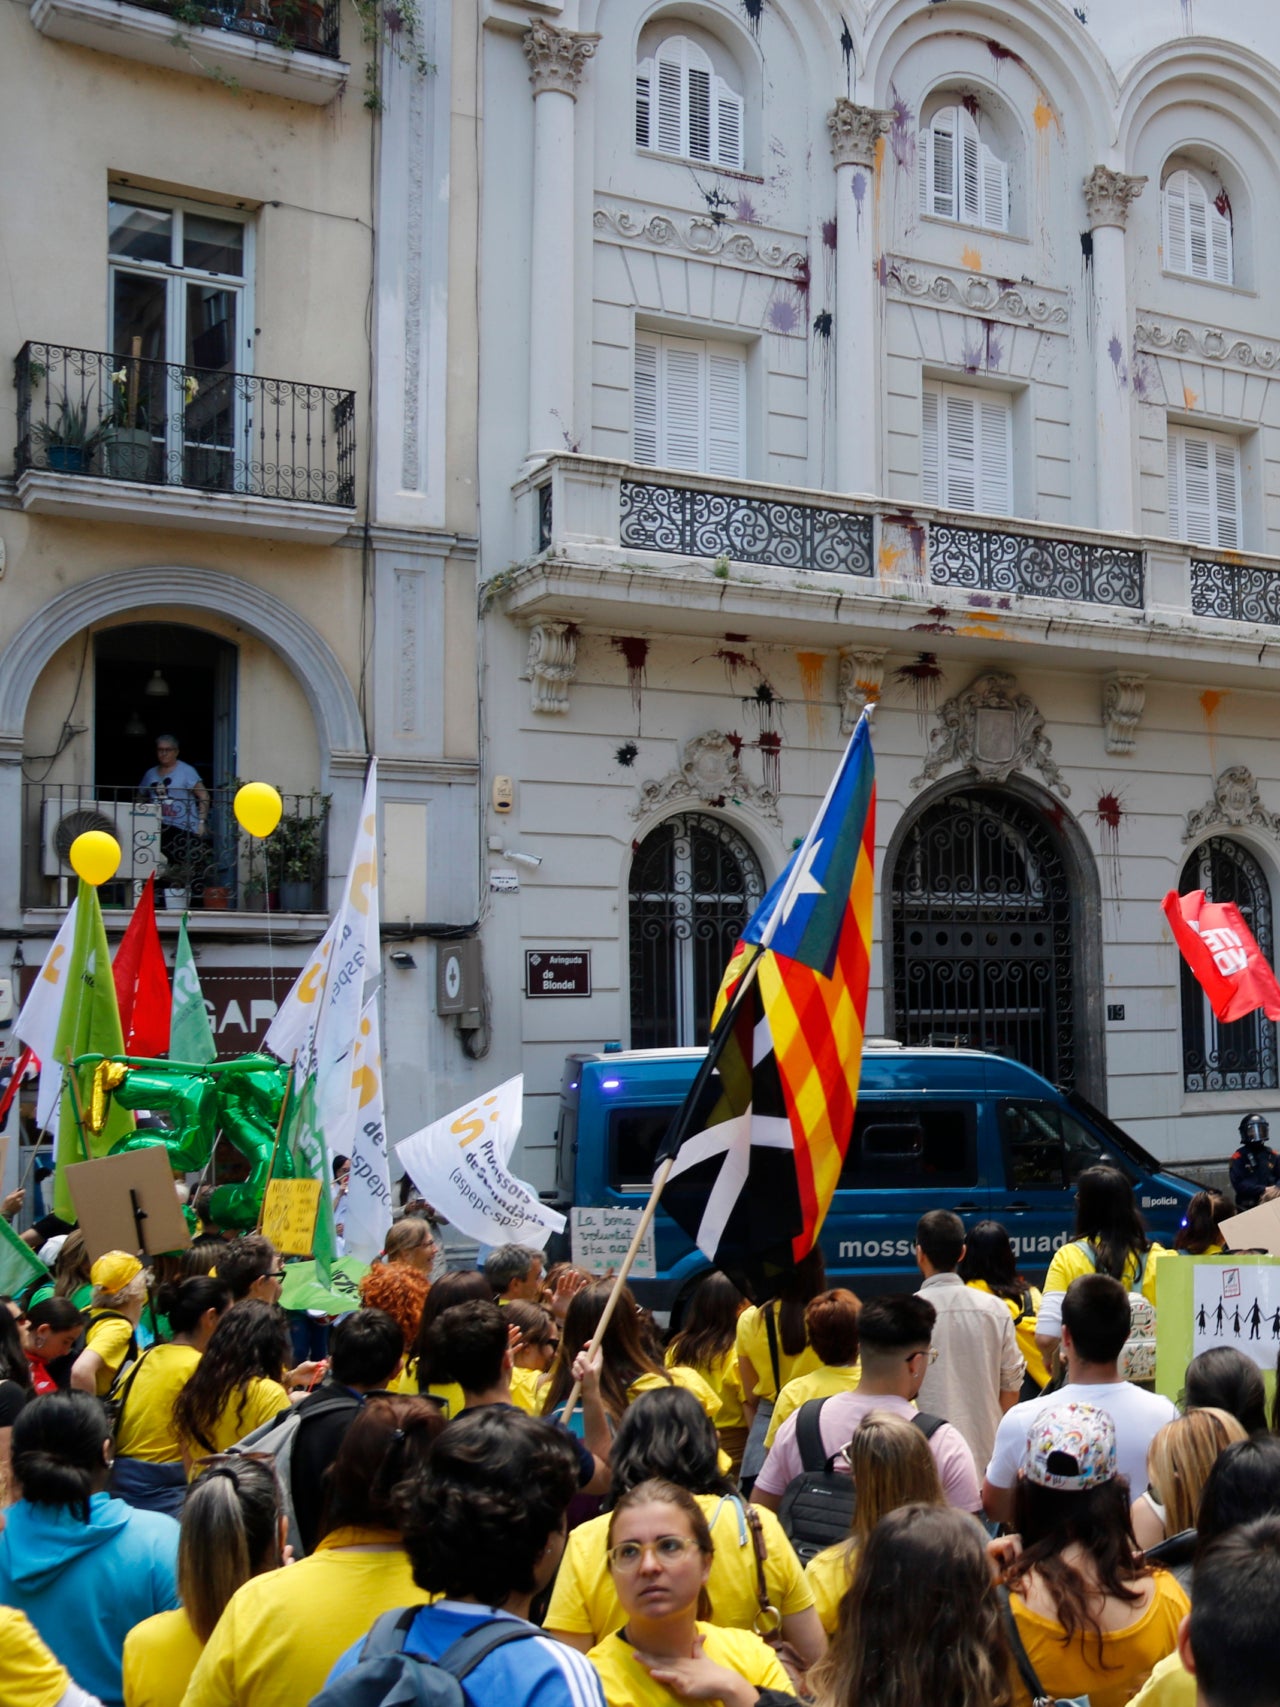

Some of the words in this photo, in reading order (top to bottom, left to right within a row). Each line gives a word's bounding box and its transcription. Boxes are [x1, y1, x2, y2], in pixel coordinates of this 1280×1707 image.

[549, 955, 583, 966] Avinguda
[542, 969, 555, 979] de
[542, 980, 575, 990] Blondel
[1151, 1196, 1178, 1207] policia
[578, 1210, 597, 1227] La
[603, 1211, 636, 1227] bona
[839, 1239, 917, 1258] moss
